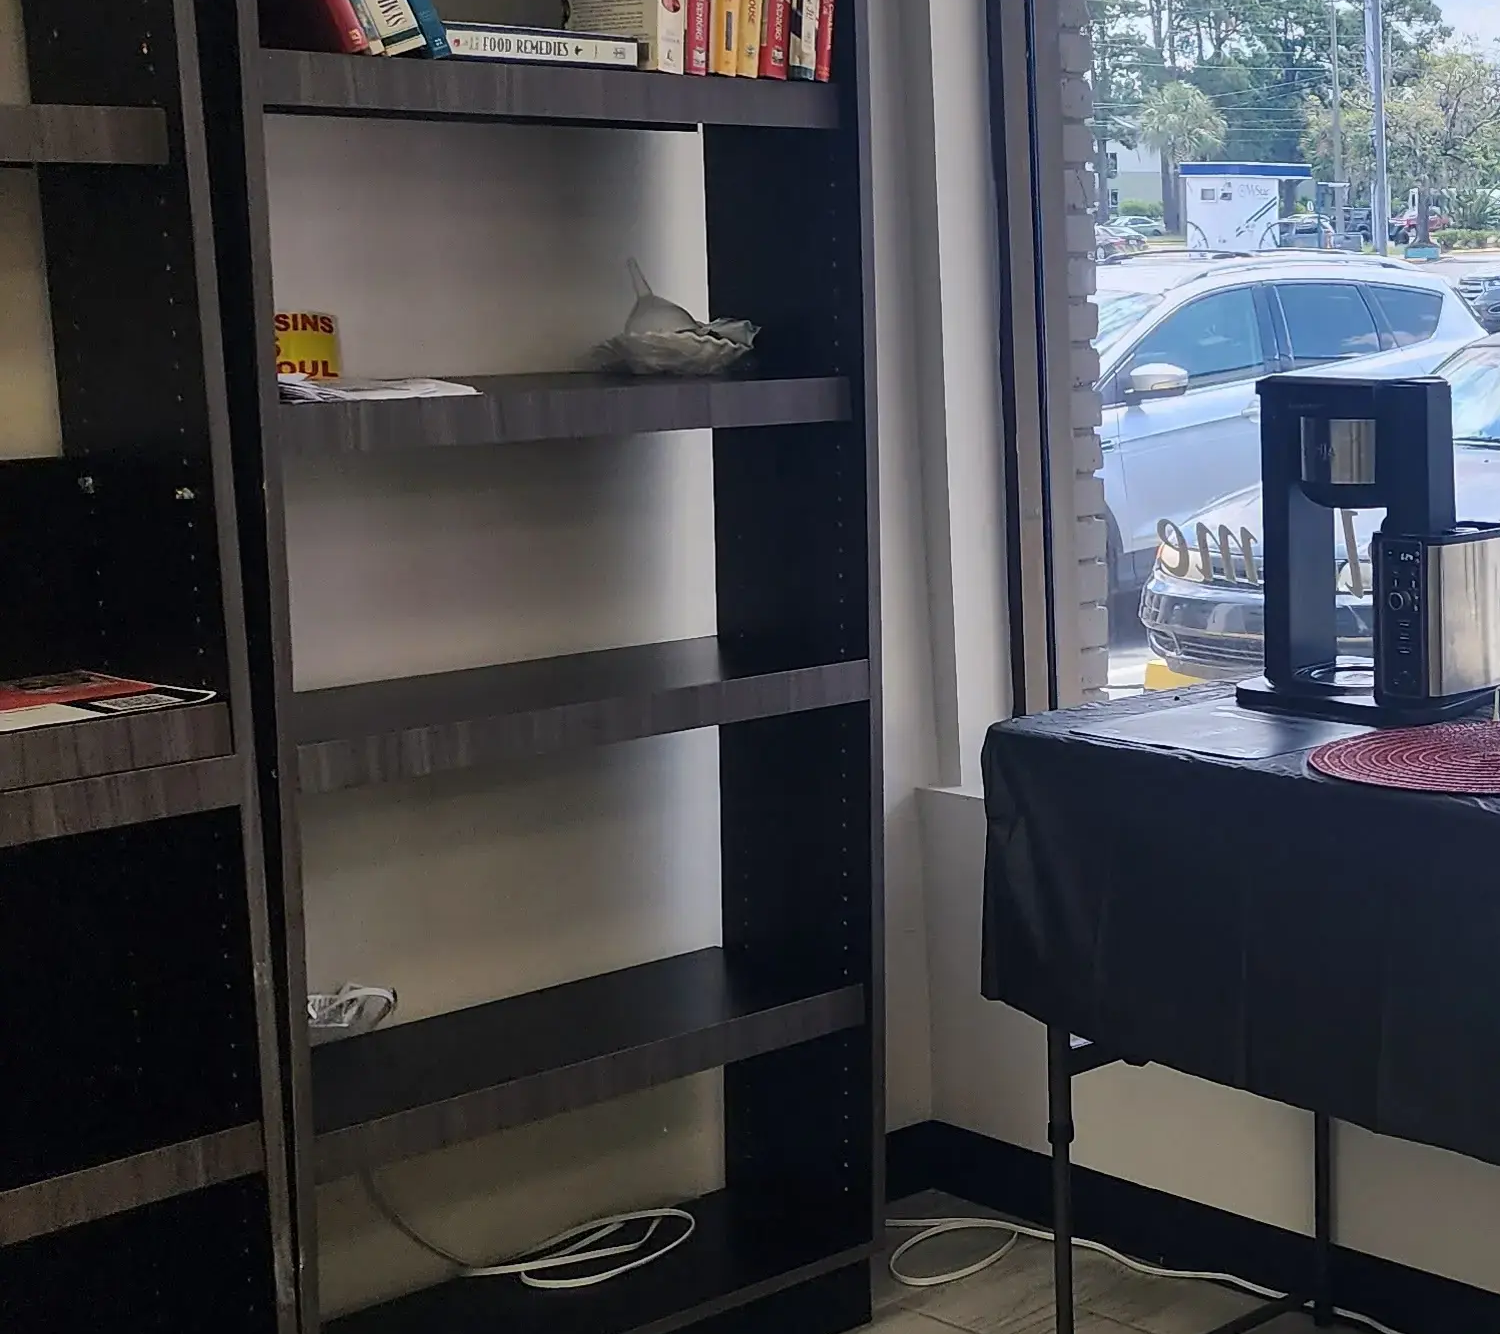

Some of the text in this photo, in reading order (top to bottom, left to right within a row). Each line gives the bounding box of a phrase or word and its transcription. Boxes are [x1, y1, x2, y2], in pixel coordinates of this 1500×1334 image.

[773, 2, 784, 42] SENIORS
[482, 36, 512, 53] FOOD
[516, 38, 569, 57] REMEDIES
[275, 313, 334, 334] SINS
[277, 360, 339, 378] OUL
